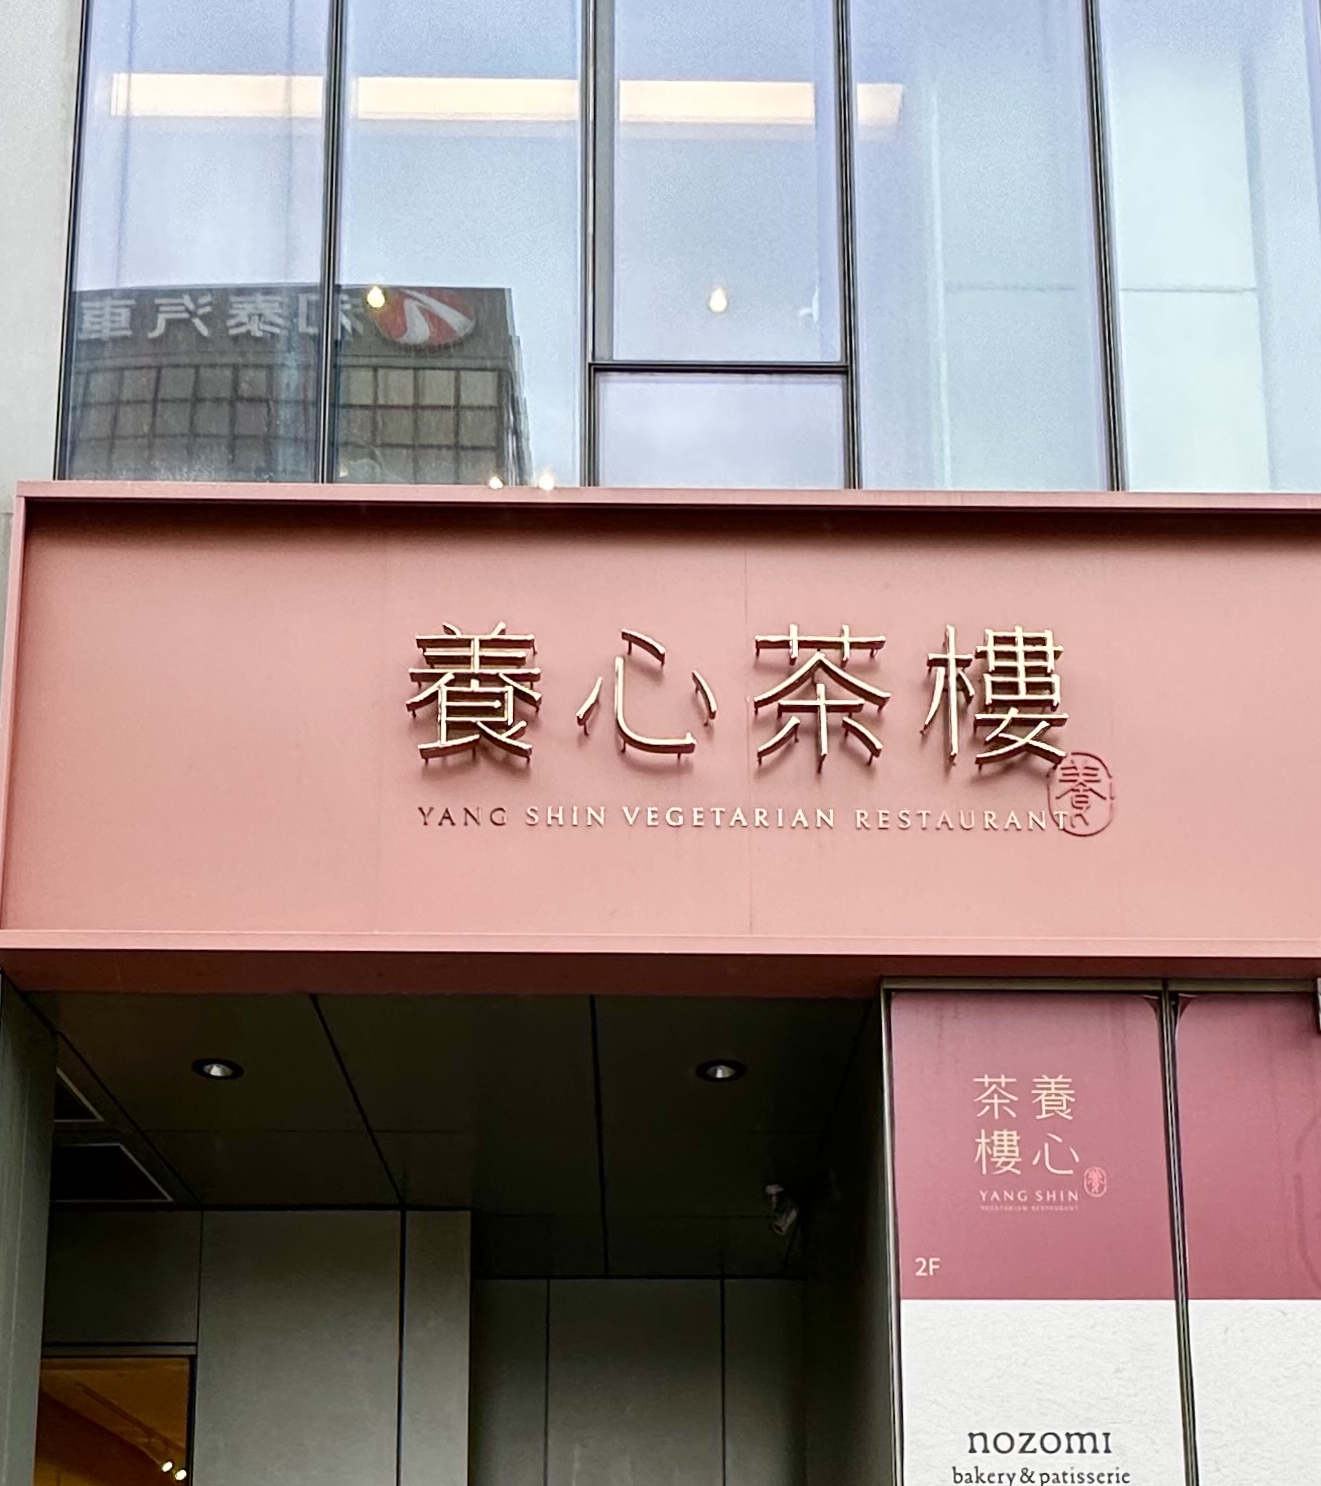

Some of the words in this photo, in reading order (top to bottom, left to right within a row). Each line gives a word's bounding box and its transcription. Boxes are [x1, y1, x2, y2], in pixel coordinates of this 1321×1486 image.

[406, 621, 1069, 770] 養心茶樓
[418, 807, 508, 827] YANG
[526, 806, 606, 827] SHIN
[623, 807, 836, 829] VEGETARIAN
[855, 809, 1069, 831] RESTAURANT
[979, 1189, 1029, 1203] YANG
[1035, 1189, 1079, 1203] SHIN
[914, 1256, 941, 1277] 2F
